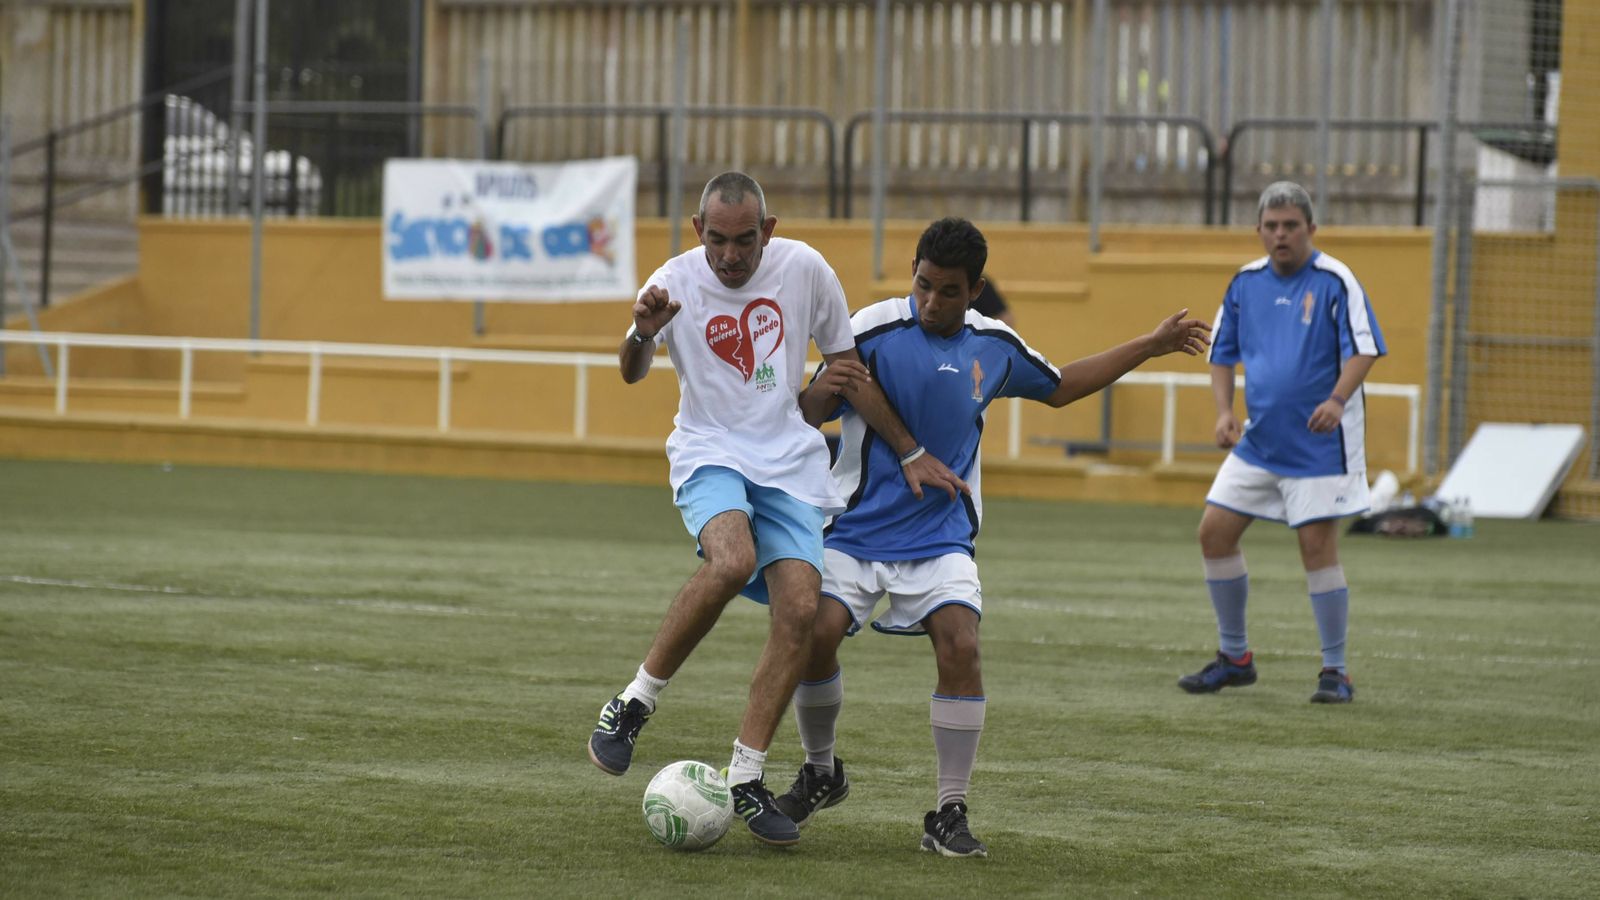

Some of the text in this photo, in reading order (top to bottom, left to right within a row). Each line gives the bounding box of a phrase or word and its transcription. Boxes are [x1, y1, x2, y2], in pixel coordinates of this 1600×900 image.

[708, 328, 737, 346] quieres
[710, 325, 718, 334] Si
[753, 319, 778, 341] puedo
